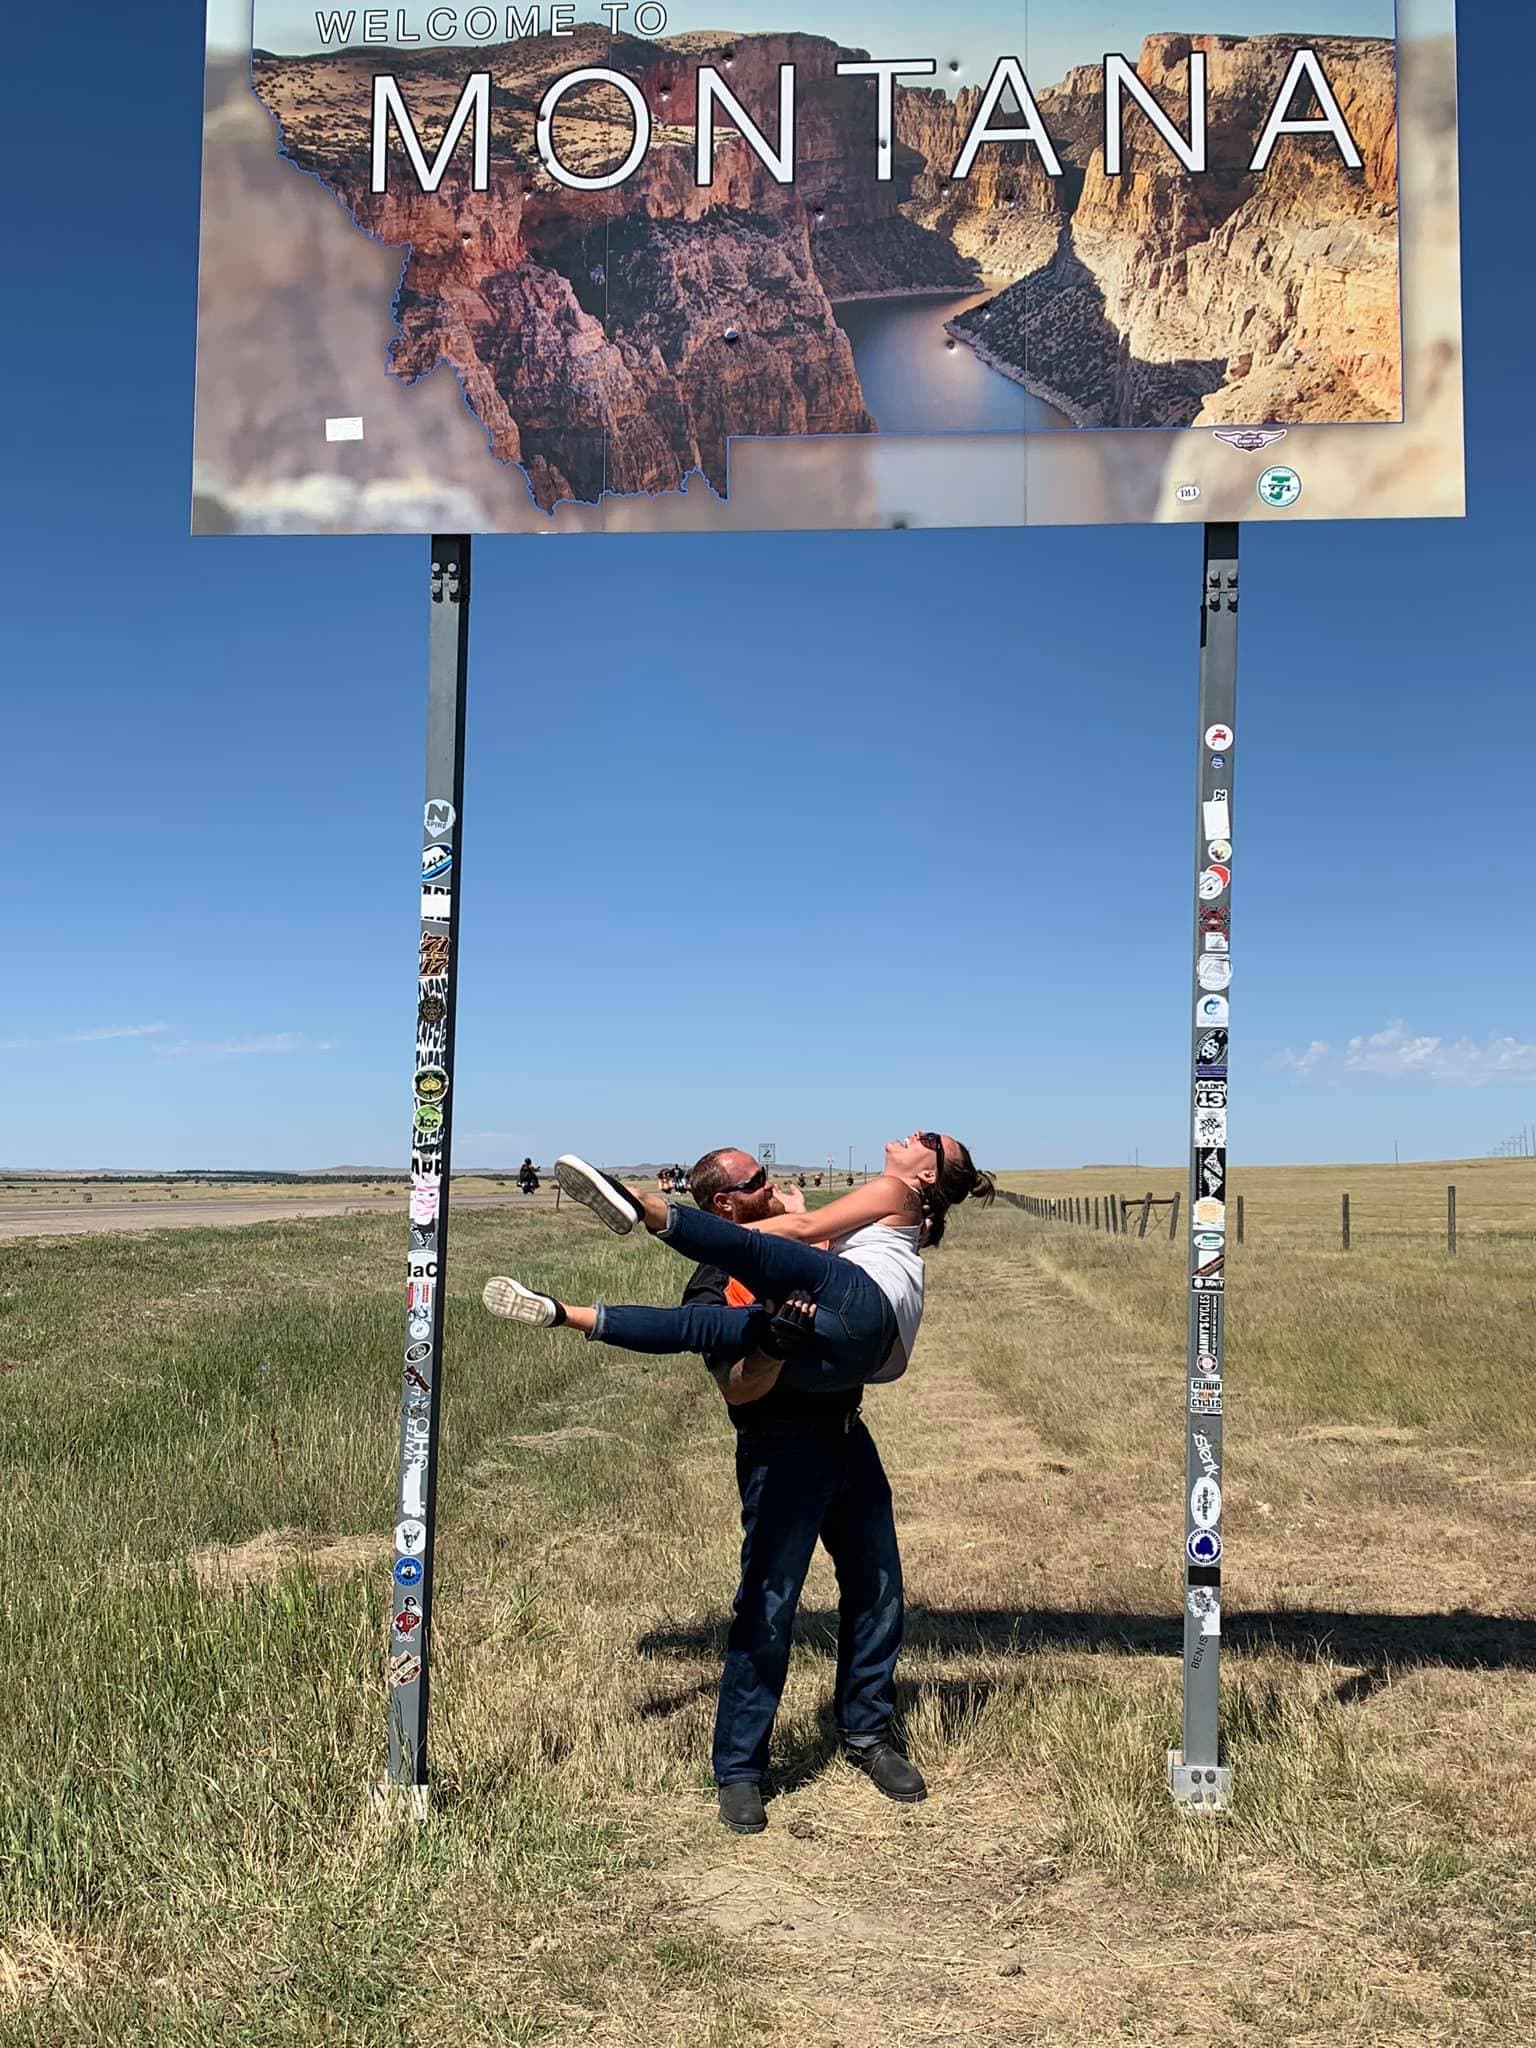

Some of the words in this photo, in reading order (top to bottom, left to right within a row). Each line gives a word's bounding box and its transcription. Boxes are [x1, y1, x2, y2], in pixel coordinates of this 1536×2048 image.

[316, 4, 577, 44] WELCOME
[609, 1, 670, 37] TO
[370, 48, 1364, 195] MONTANA
[1198, 1092, 1225, 1107] 13
[1199, 1294, 1210, 1321] CYCLES
[1198, 1322, 1210, 1354] DANNY'S
[1193, 1382, 1221, 1391] CLOUD
[1191, 1647, 1205, 1670] BEN
[1198, 1635, 1209, 1647] IS
